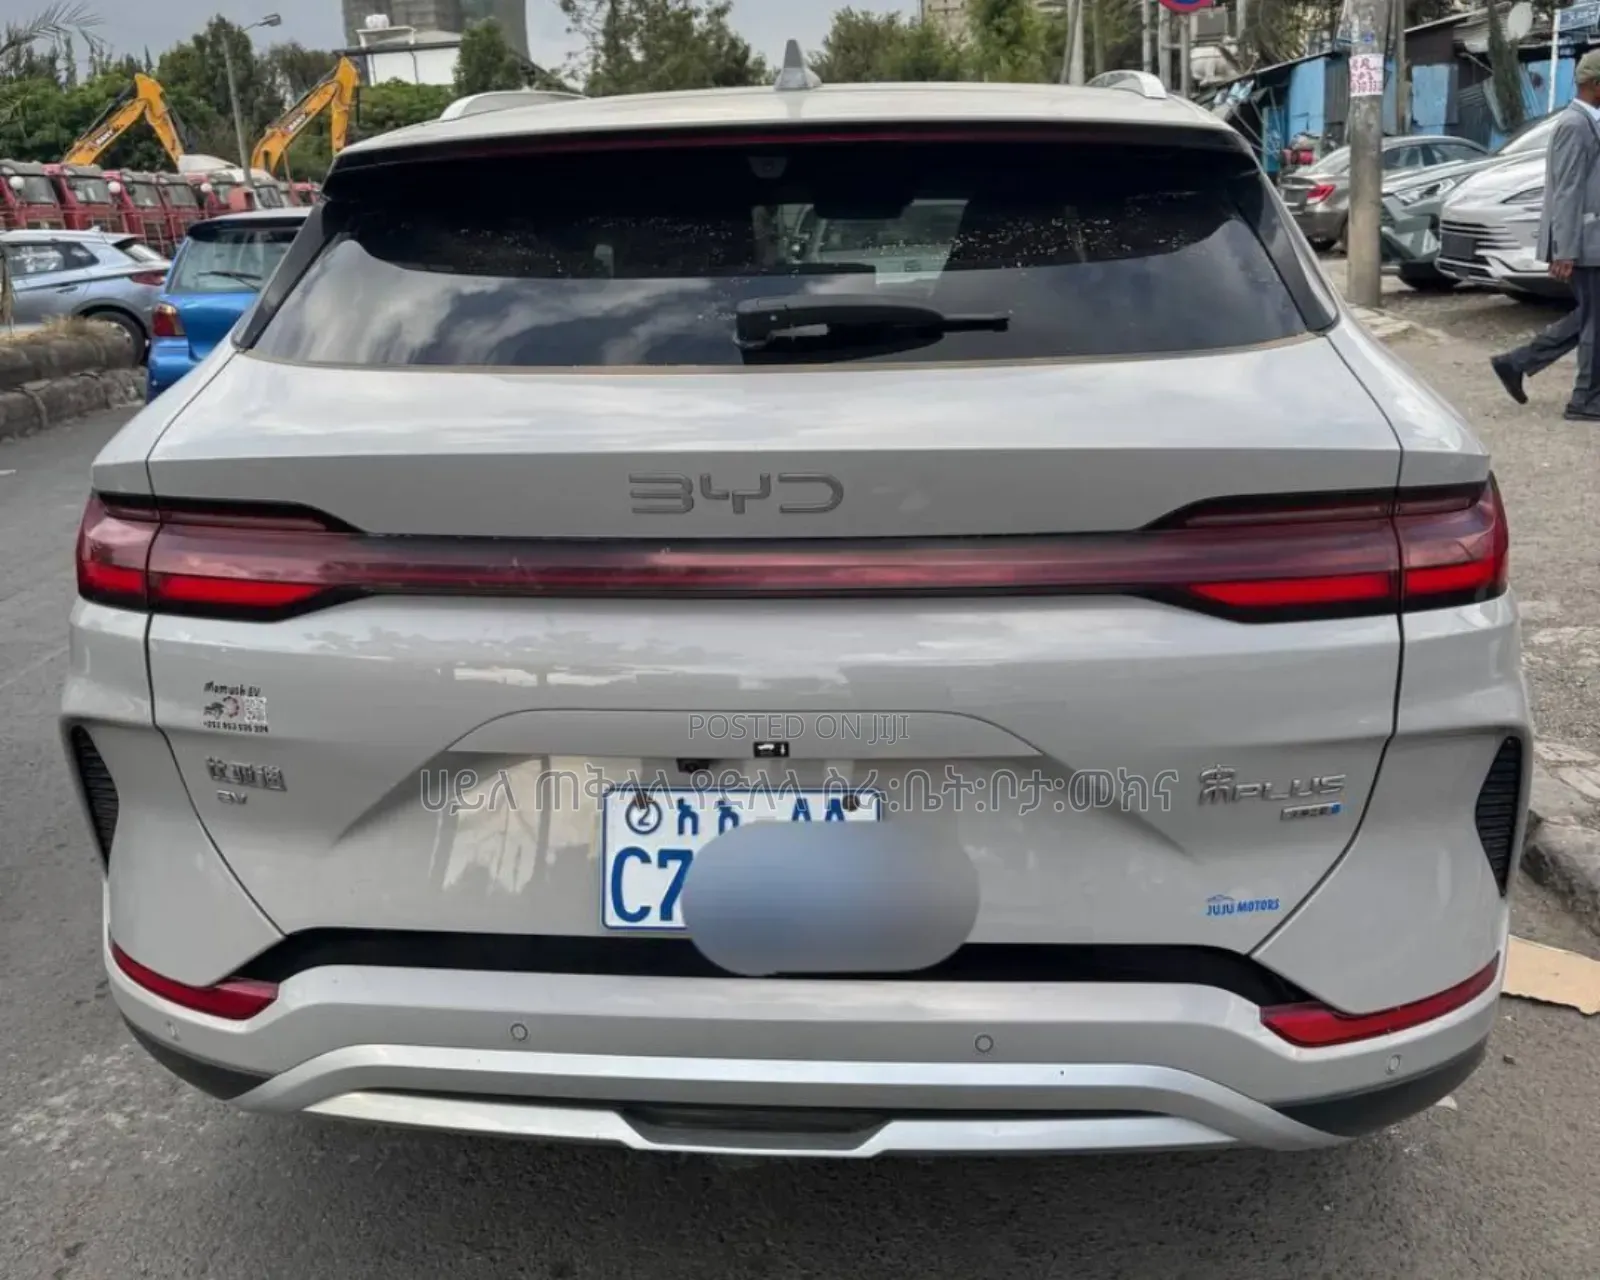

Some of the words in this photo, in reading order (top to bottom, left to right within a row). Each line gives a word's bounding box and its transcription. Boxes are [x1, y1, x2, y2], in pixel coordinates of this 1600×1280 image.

[628, 472, 844, 514] BYD
[1206, 904, 1235, 916] JUJU
[1237, 899, 1280, 913] MOTORS
